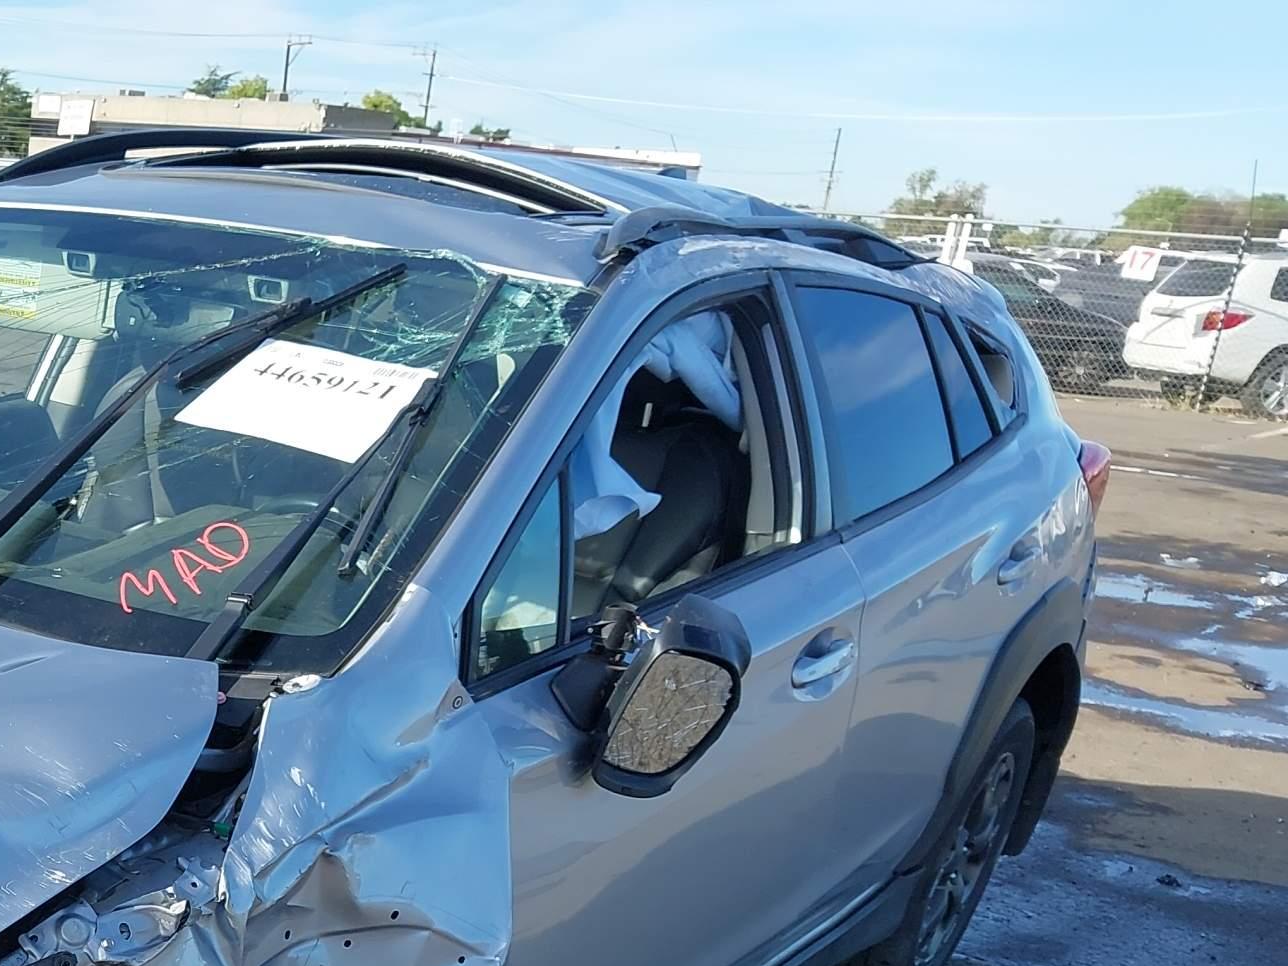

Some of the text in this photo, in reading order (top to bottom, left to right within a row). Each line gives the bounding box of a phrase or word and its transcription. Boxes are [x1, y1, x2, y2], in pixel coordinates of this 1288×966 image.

[1129, 249, 1156, 272] 17
[253, 361, 397, 400] 44659121
[119, 521, 249, 614] MAD
